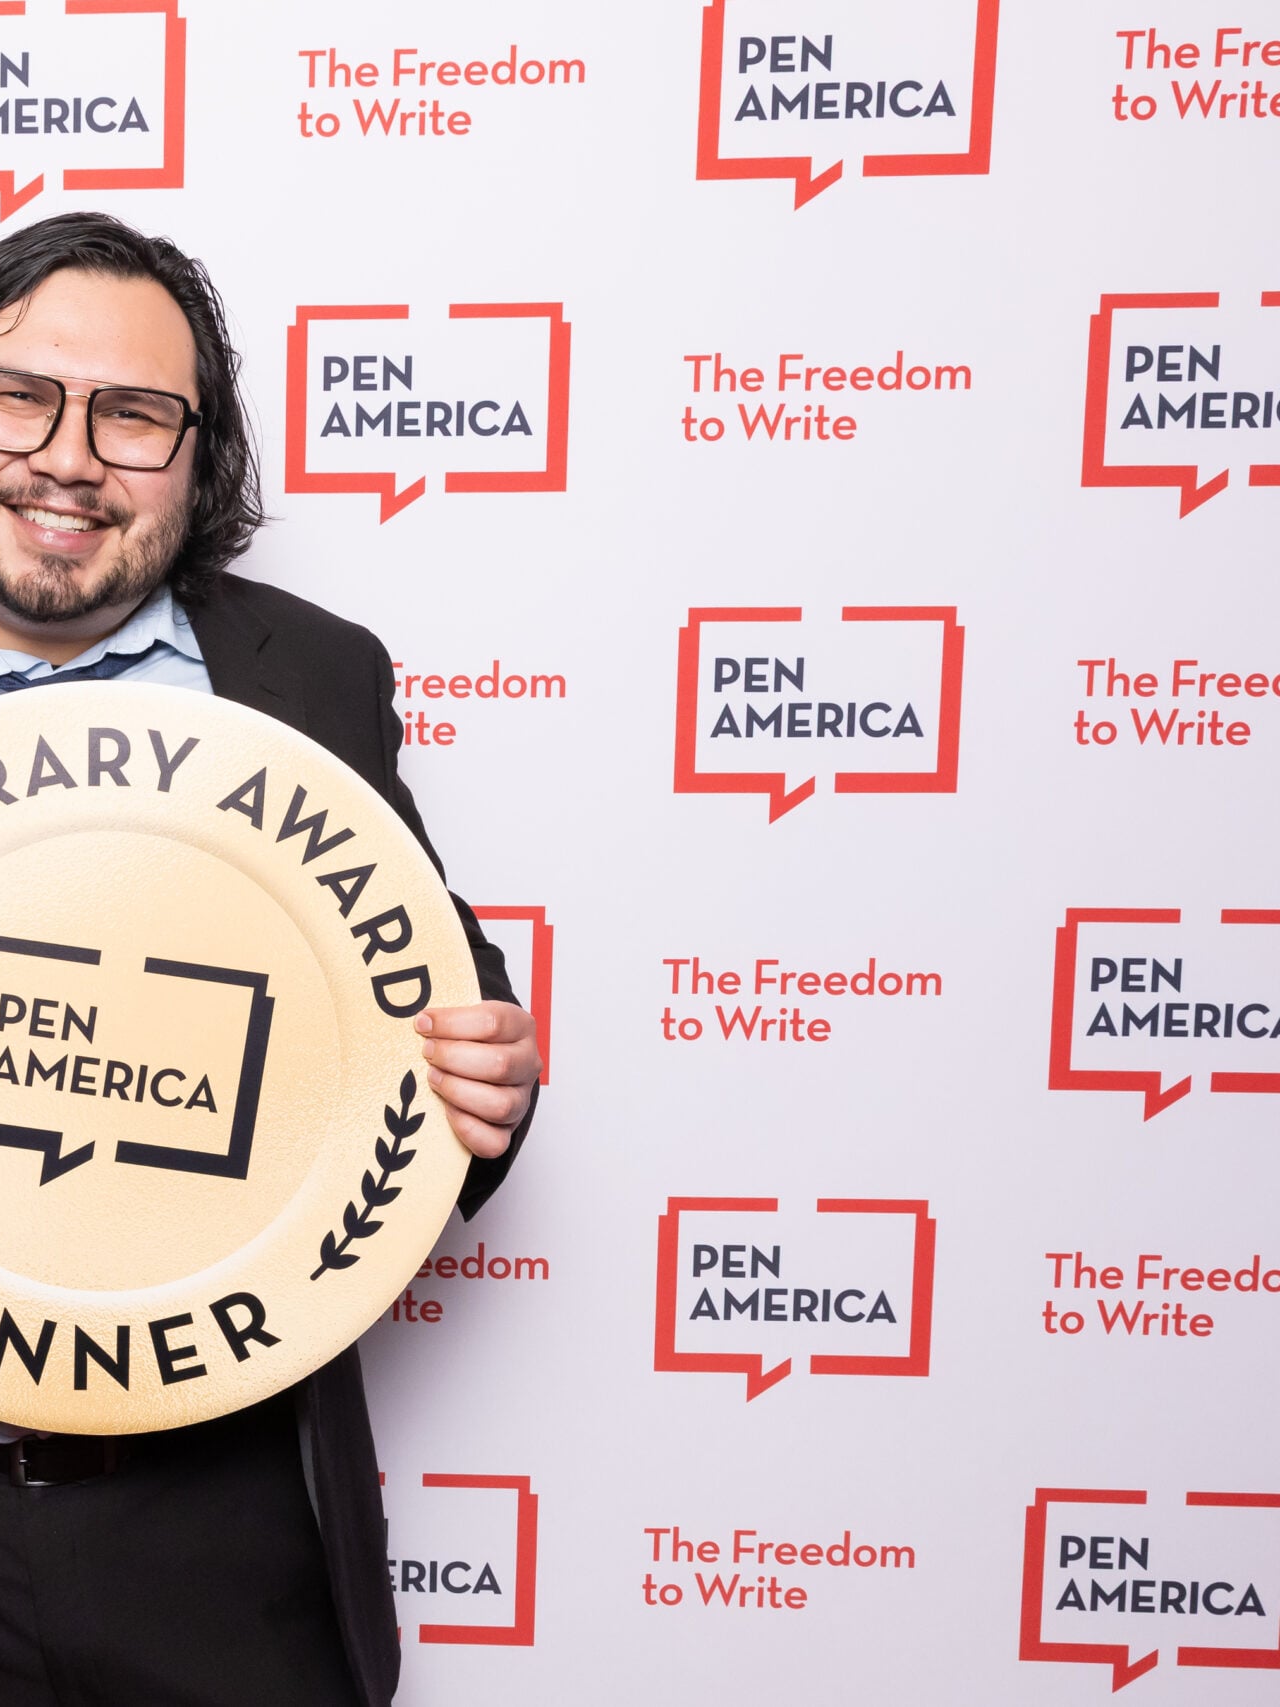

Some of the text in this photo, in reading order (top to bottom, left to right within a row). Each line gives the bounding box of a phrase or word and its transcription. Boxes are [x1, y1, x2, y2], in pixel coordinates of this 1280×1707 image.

[298, 44, 586, 88] The Freedom
[739, 35, 833, 74] PEN
[1115, 27, 1201, 71] The
[297, 98, 472, 138] to Write
[734, 80, 956, 121] AMERICA
[1111, 83, 1158, 122] to
[323, 355, 412, 391] PEN
[683, 349, 972, 393] The Freedom
[1125, 344, 1221, 382] PEN
[320, 400, 533, 437] AMERICA
[681, 402, 858, 442] to Write
[1120, 391, 1280, 429] AMERI
[714, 657, 805, 693] PEN
[1076, 657, 1159, 698] The
[404, 710, 457, 746] ite
[710, 702, 924, 738] AMERICA
[1073, 707, 1252, 747] to Write
[215, 765, 432, 1020] AWARD
[662, 956, 943, 997] The Freedom
[1090, 957, 1183, 993] PEN
[660, 1005, 832, 1043] to Write
[414, 1242, 550, 1281] eedom
[692, 1244, 781, 1279] PEN
[1044, 1251, 1125, 1290] The
[689, 1287, 897, 1324] AMERICA
[1041, 1299, 1215, 1338] to Write
[643, 1525, 916, 1569] The Freedom
[1059, 1535, 1149, 1571] PEN
[642, 1572, 808, 1610] to Write
[1055, 1578, 1266, 1617] AMERICA
